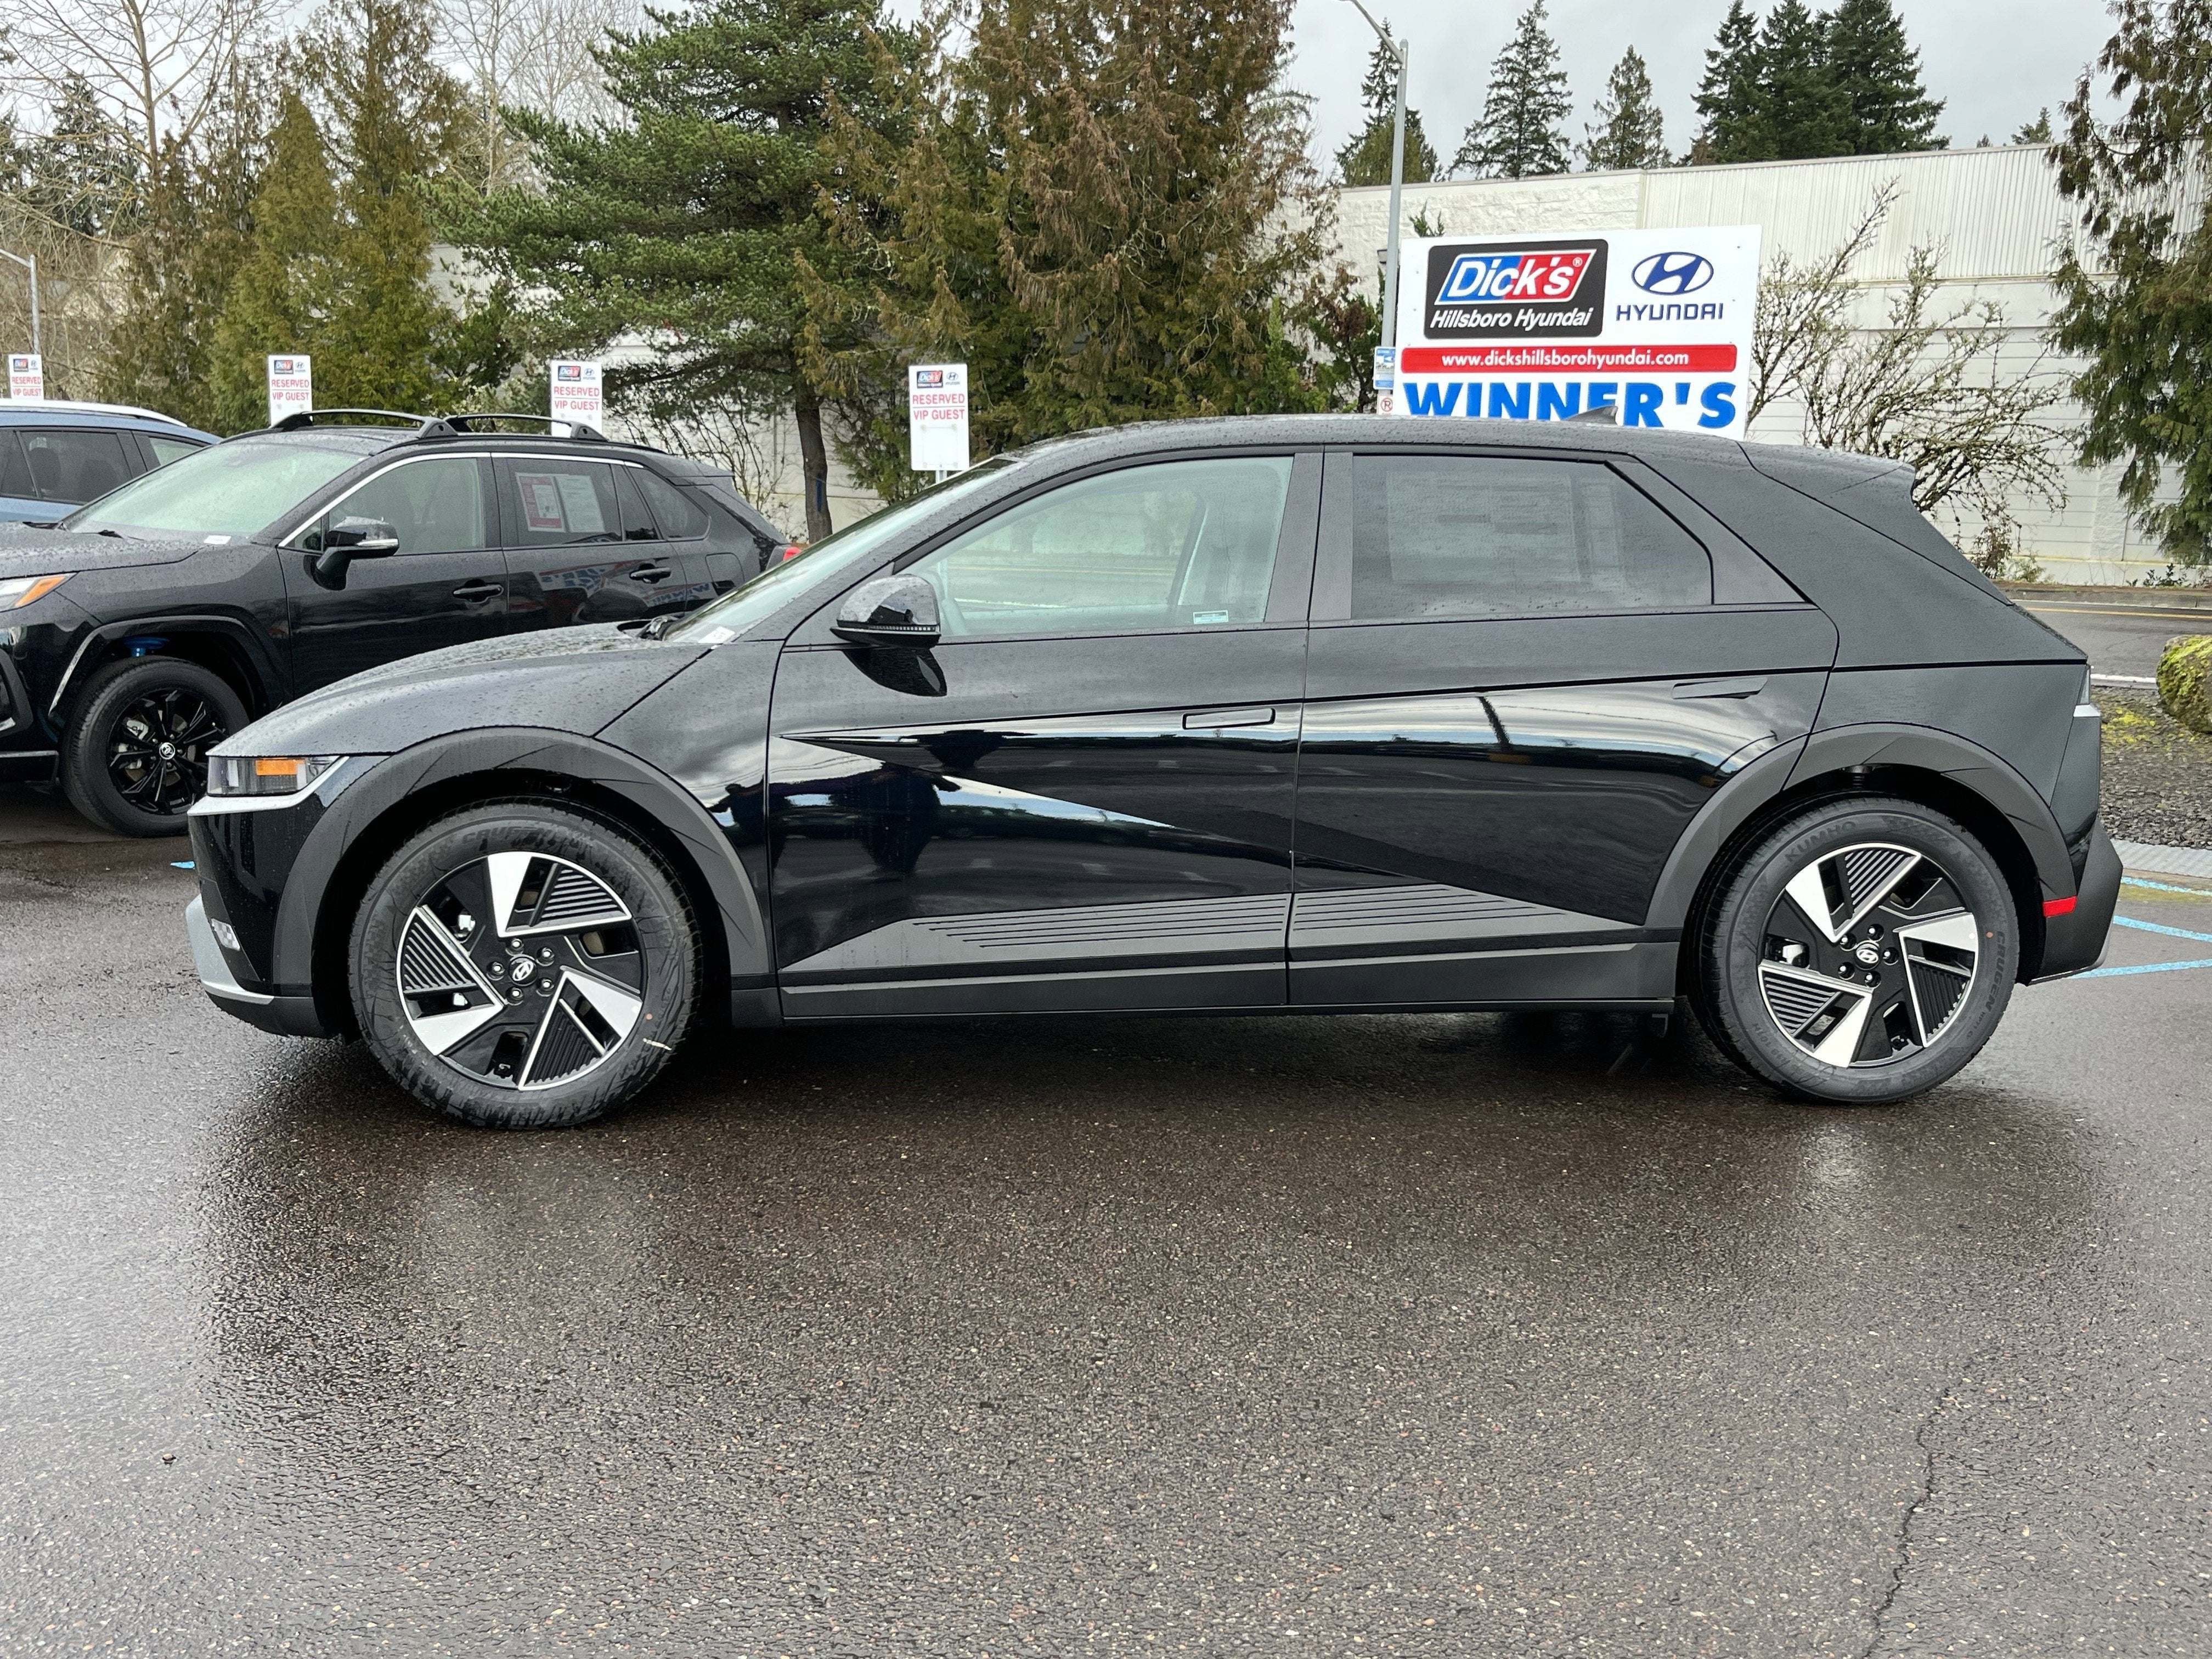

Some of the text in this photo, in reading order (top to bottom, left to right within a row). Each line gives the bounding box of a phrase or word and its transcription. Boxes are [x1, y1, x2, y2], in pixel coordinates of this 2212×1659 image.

[1431, 306, 1593, 331] Hillsboro Hyundai
[1616, 303, 1723, 321] HYUNDAI
[1441, 349, 1689, 370] www.dickshillsborohyundai.com
[272, 379, 309, 388] RESERVED
[273, 392, 309, 400] VIP GUEST
[554, 386, 600, 397] RESERVED
[912, 393, 965, 404] RESERVED
[554, 400, 600, 410] VIP GUEST
[1403, 382, 1736, 428] WINNER'S
[913, 409, 965, 420] VIP GUEST
[1785, 821, 1857, 862] KUMHO
[1985, 930, 2006, 1013] CRUGEN
